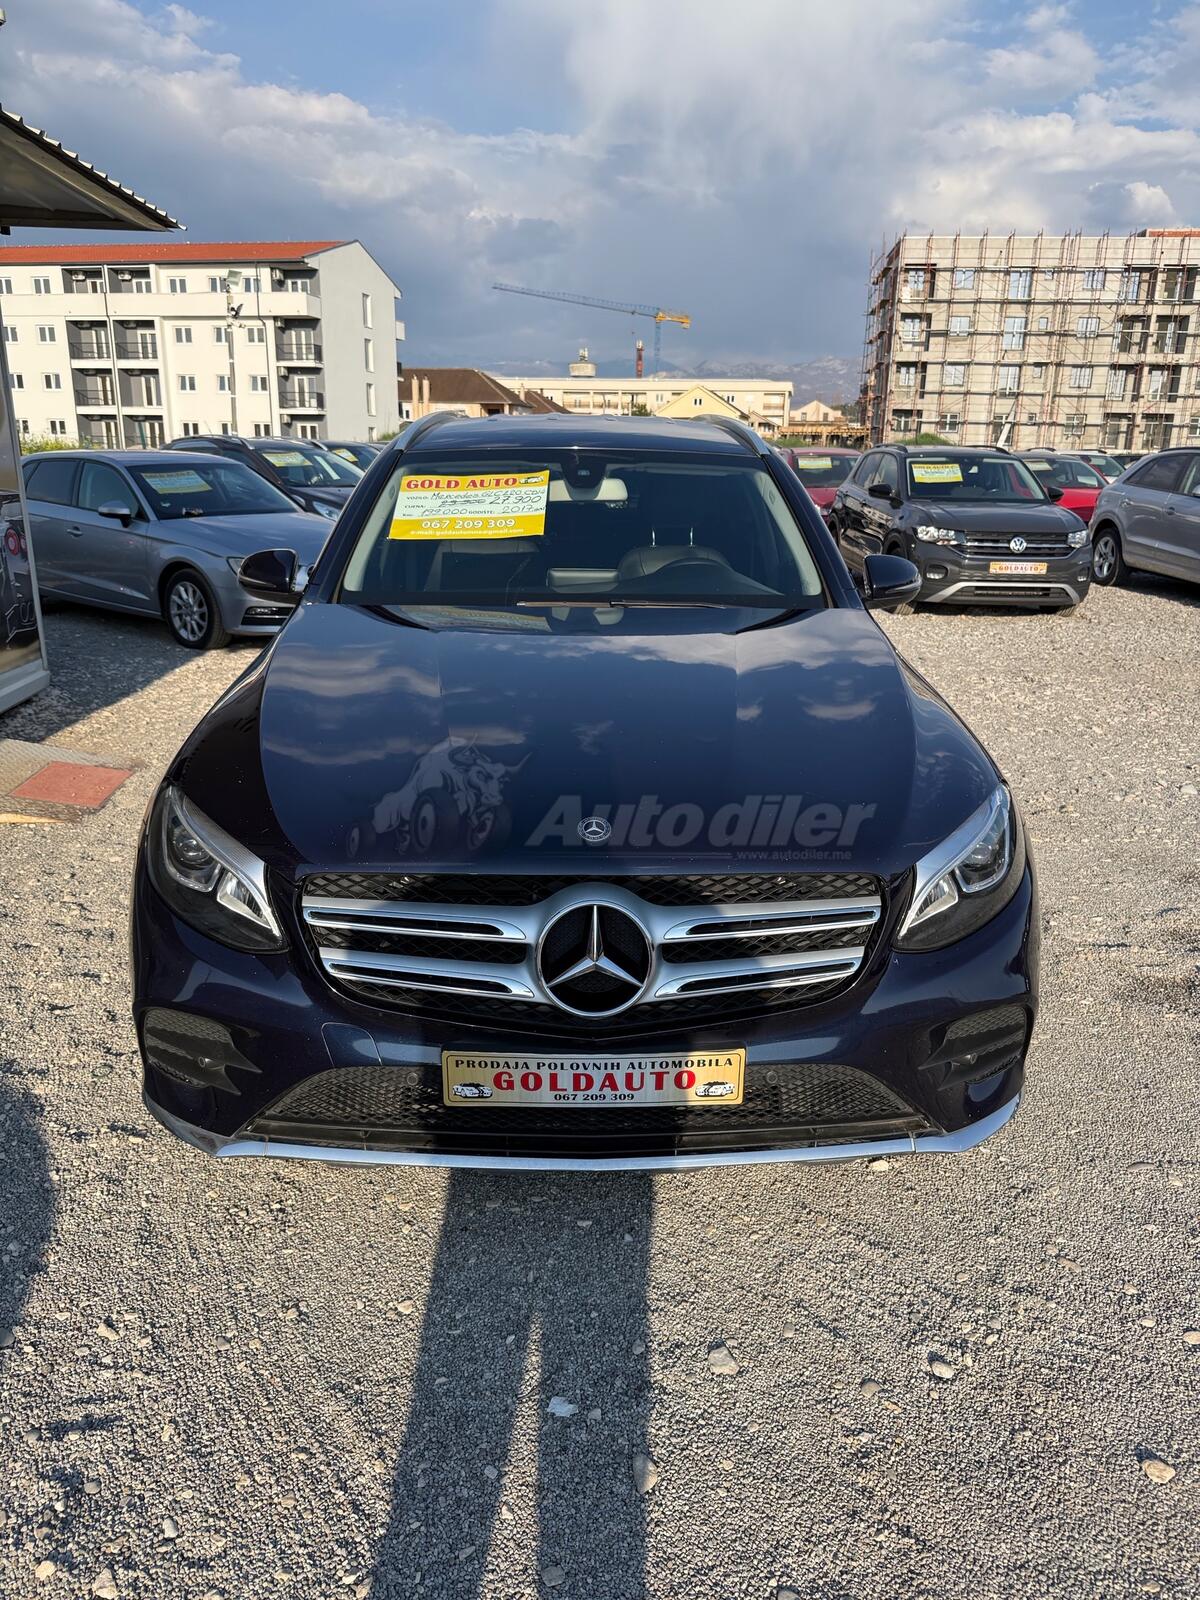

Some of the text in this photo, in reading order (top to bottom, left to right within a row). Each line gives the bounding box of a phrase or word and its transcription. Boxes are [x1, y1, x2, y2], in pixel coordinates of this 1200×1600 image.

[406, 477, 517, 489] GOLD AUTO
[422, 519, 515, 529] 067 209 309
[455, 1057, 733, 1071] PRODAJA POLOVNIH AUTOMOBILA
[492, 1070, 696, 1093] GOLDAUTO
[554, 1093, 635, 1102] 067 209 309
